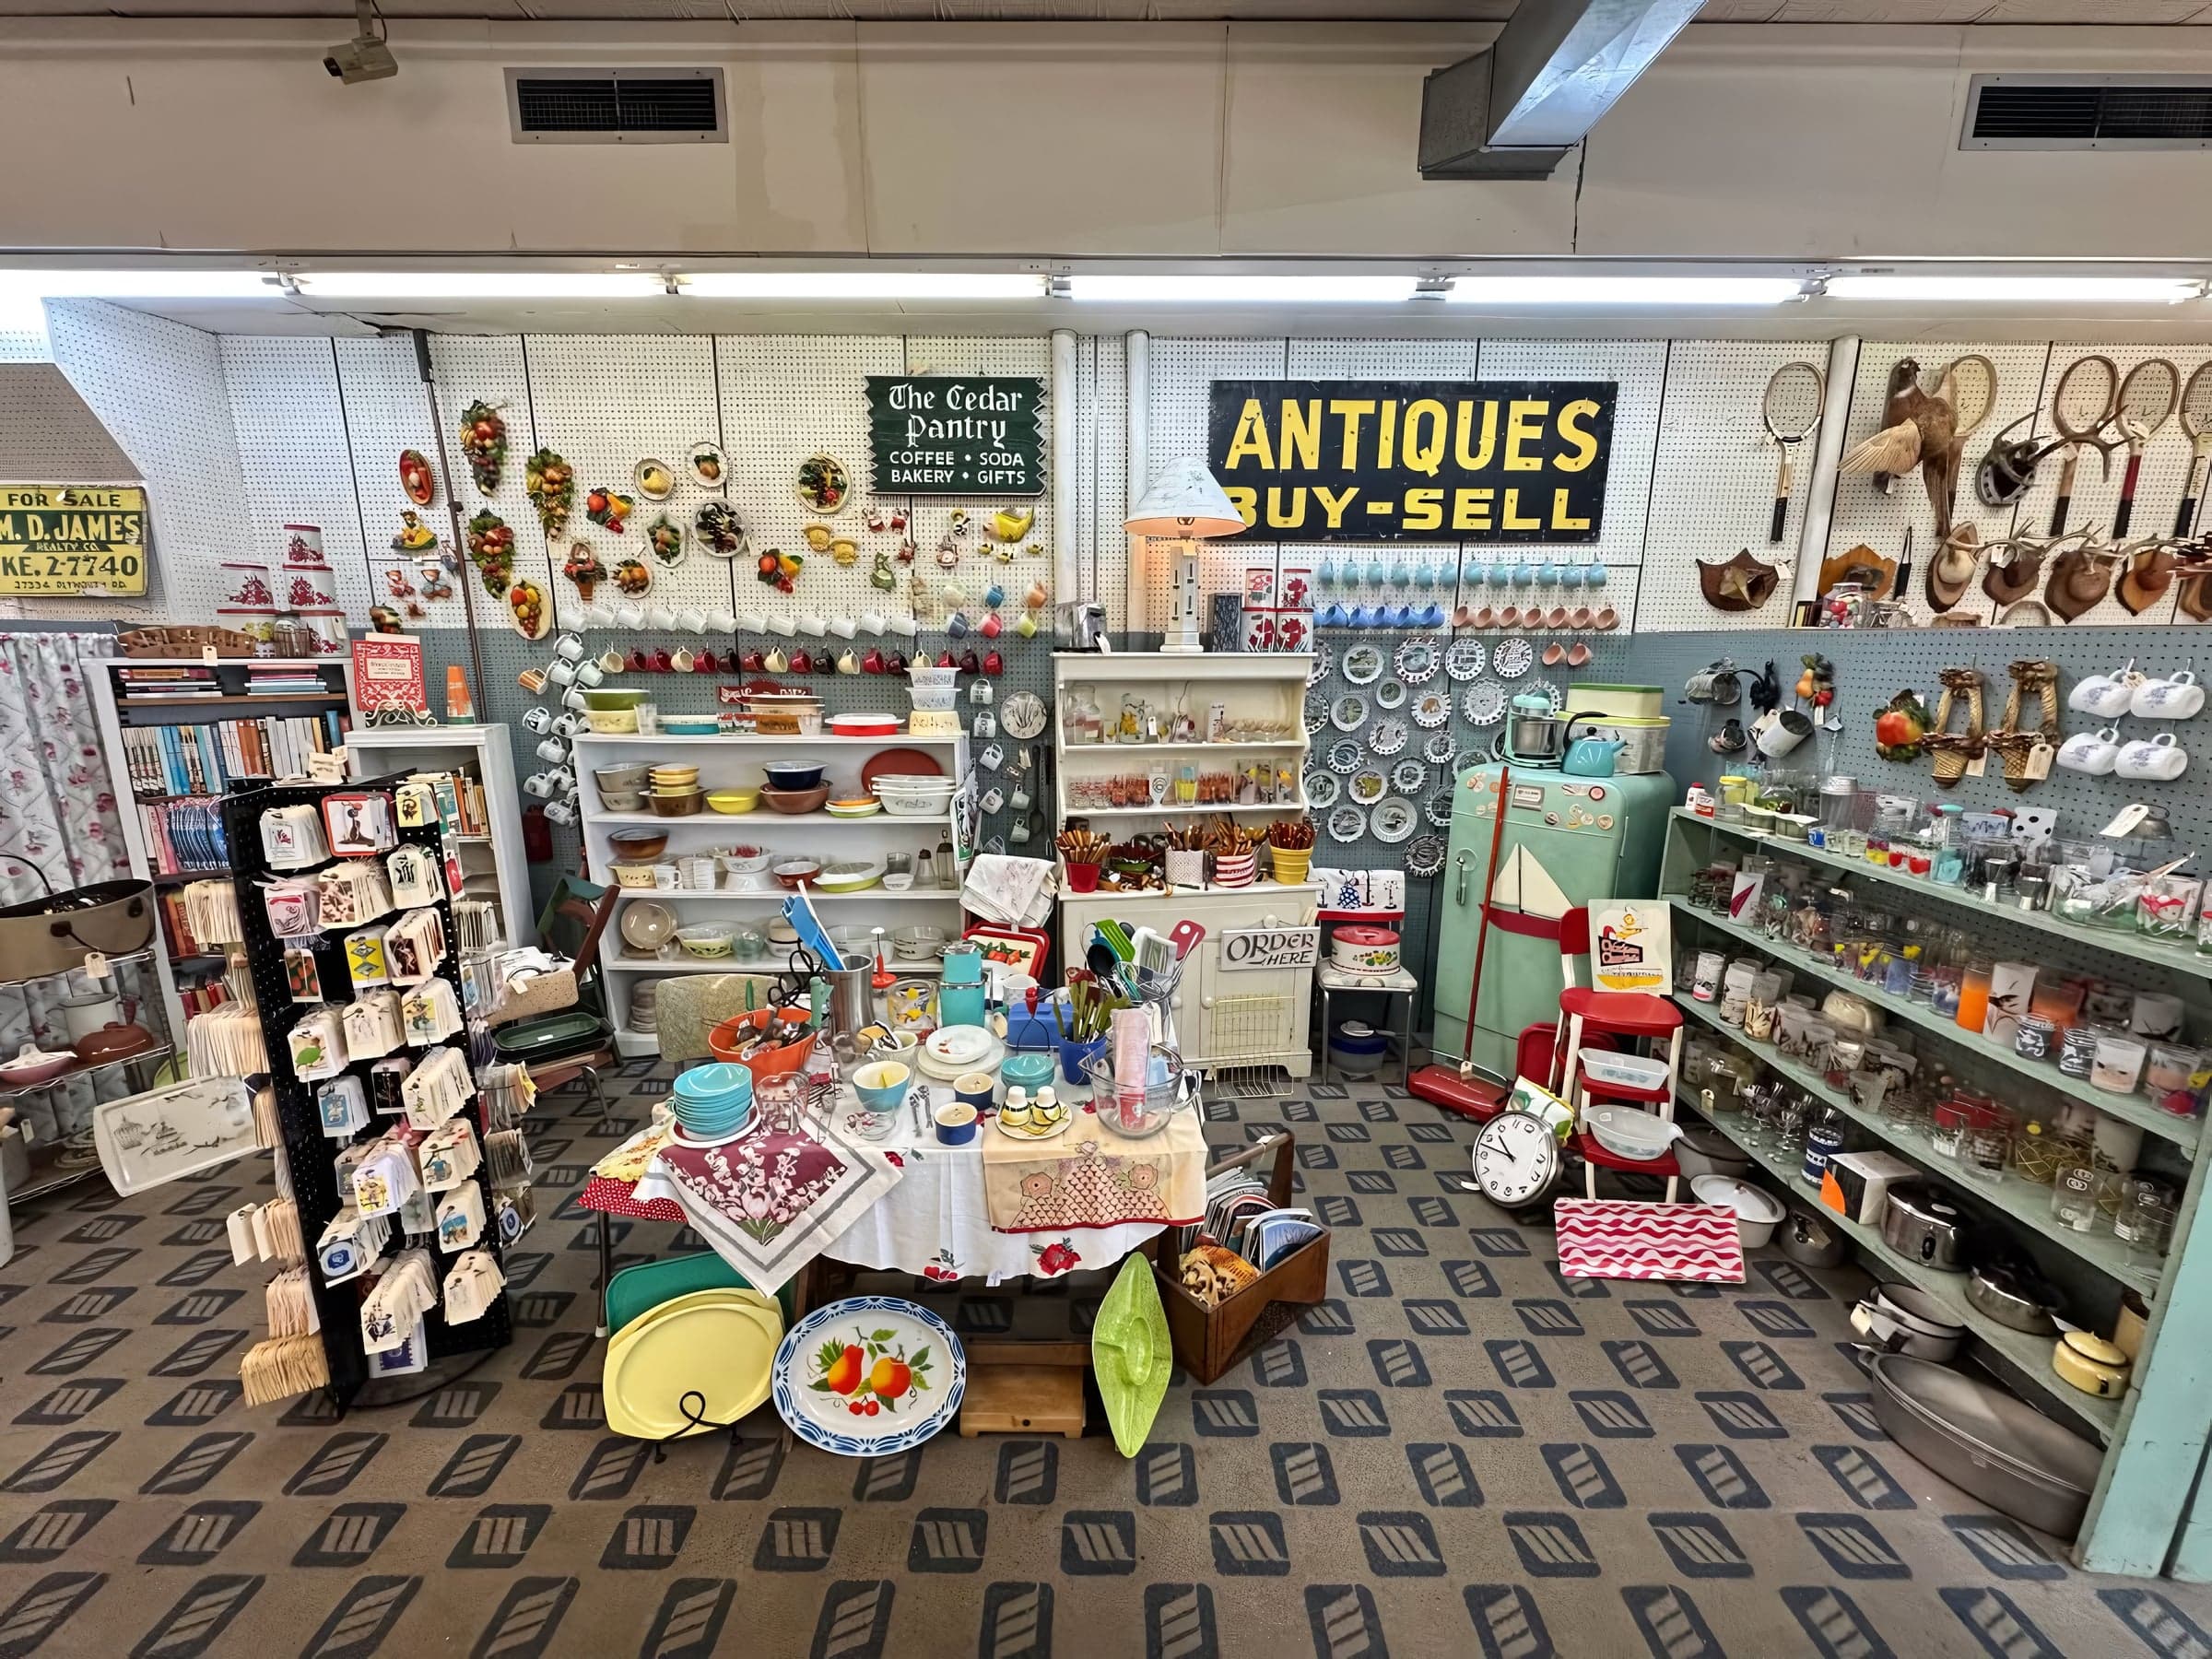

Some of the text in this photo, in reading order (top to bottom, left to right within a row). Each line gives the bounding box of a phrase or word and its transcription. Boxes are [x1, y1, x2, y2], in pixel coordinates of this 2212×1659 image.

[888, 382, 1023, 412] The Cedar
[904, 413, 1006, 450] Pantry
[1224, 397, 1602, 477] ANTIQUES
[889, 451, 1025, 466] COFFEE SODA
[891, 469, 1026, 485] BAKERY GIFTS
[8, 493, 121, 507] FOR SALE
[1220, 486, 1592, 531] BUY-SELL
[53, 514, 141, 543] JAMES
[2, 555, 139, 577] KE. 2-7740
[1227, 933, 1314, 962] ORDER
[1261, 950, 1313, 966] HERE
